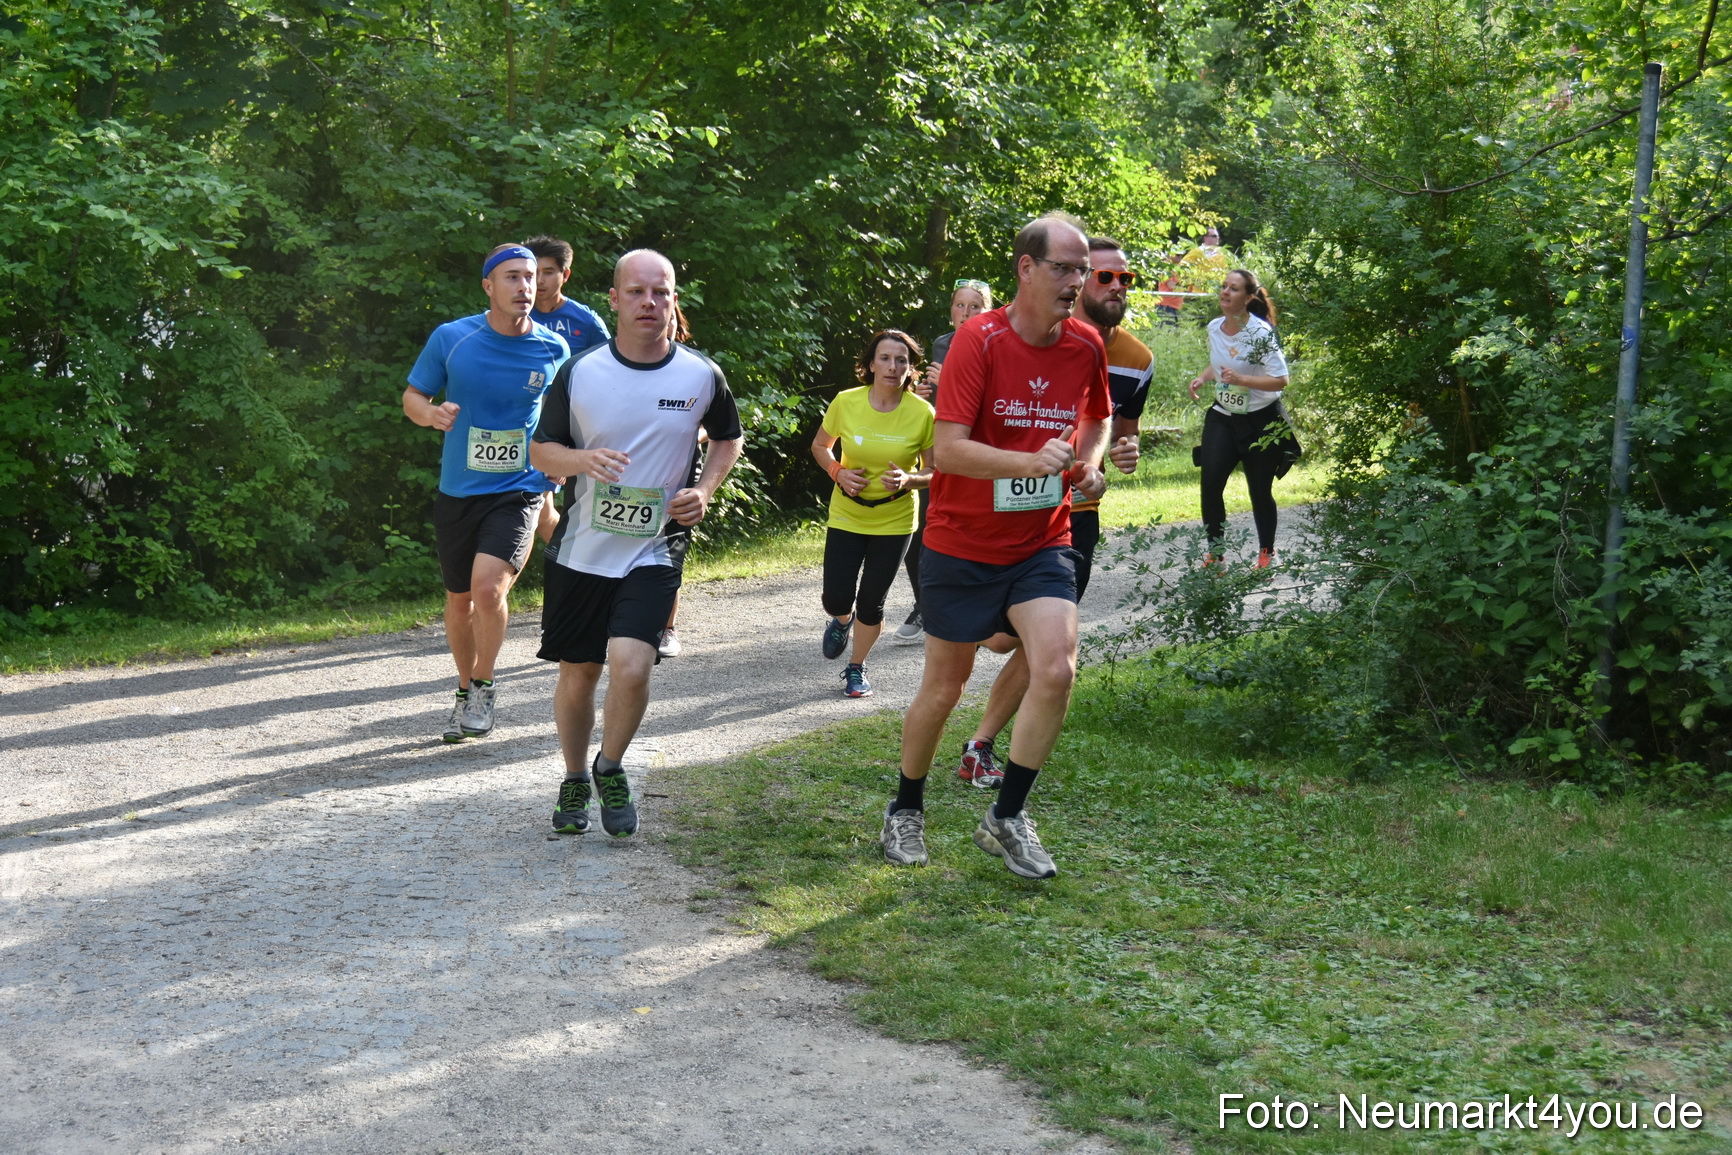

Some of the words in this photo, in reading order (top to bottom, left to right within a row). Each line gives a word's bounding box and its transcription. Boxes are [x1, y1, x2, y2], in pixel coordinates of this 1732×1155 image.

[658, 399, 686, 408] swn
[1219, 392, 1244, 406] 1356
[993, 399, 1028, 416] Echtes
[1028, 400, 1077, 421] Handwerk
[1004, 418, 1032, 428] IMMER
[1034, 420, 1066, 431] FRISCH
[474, 444, 519, 460] 2026
[1010, 474, 1049, 496] 607
[600, 500, 652, 524] 2279
[620, 522, 646, 530] Reinhard
